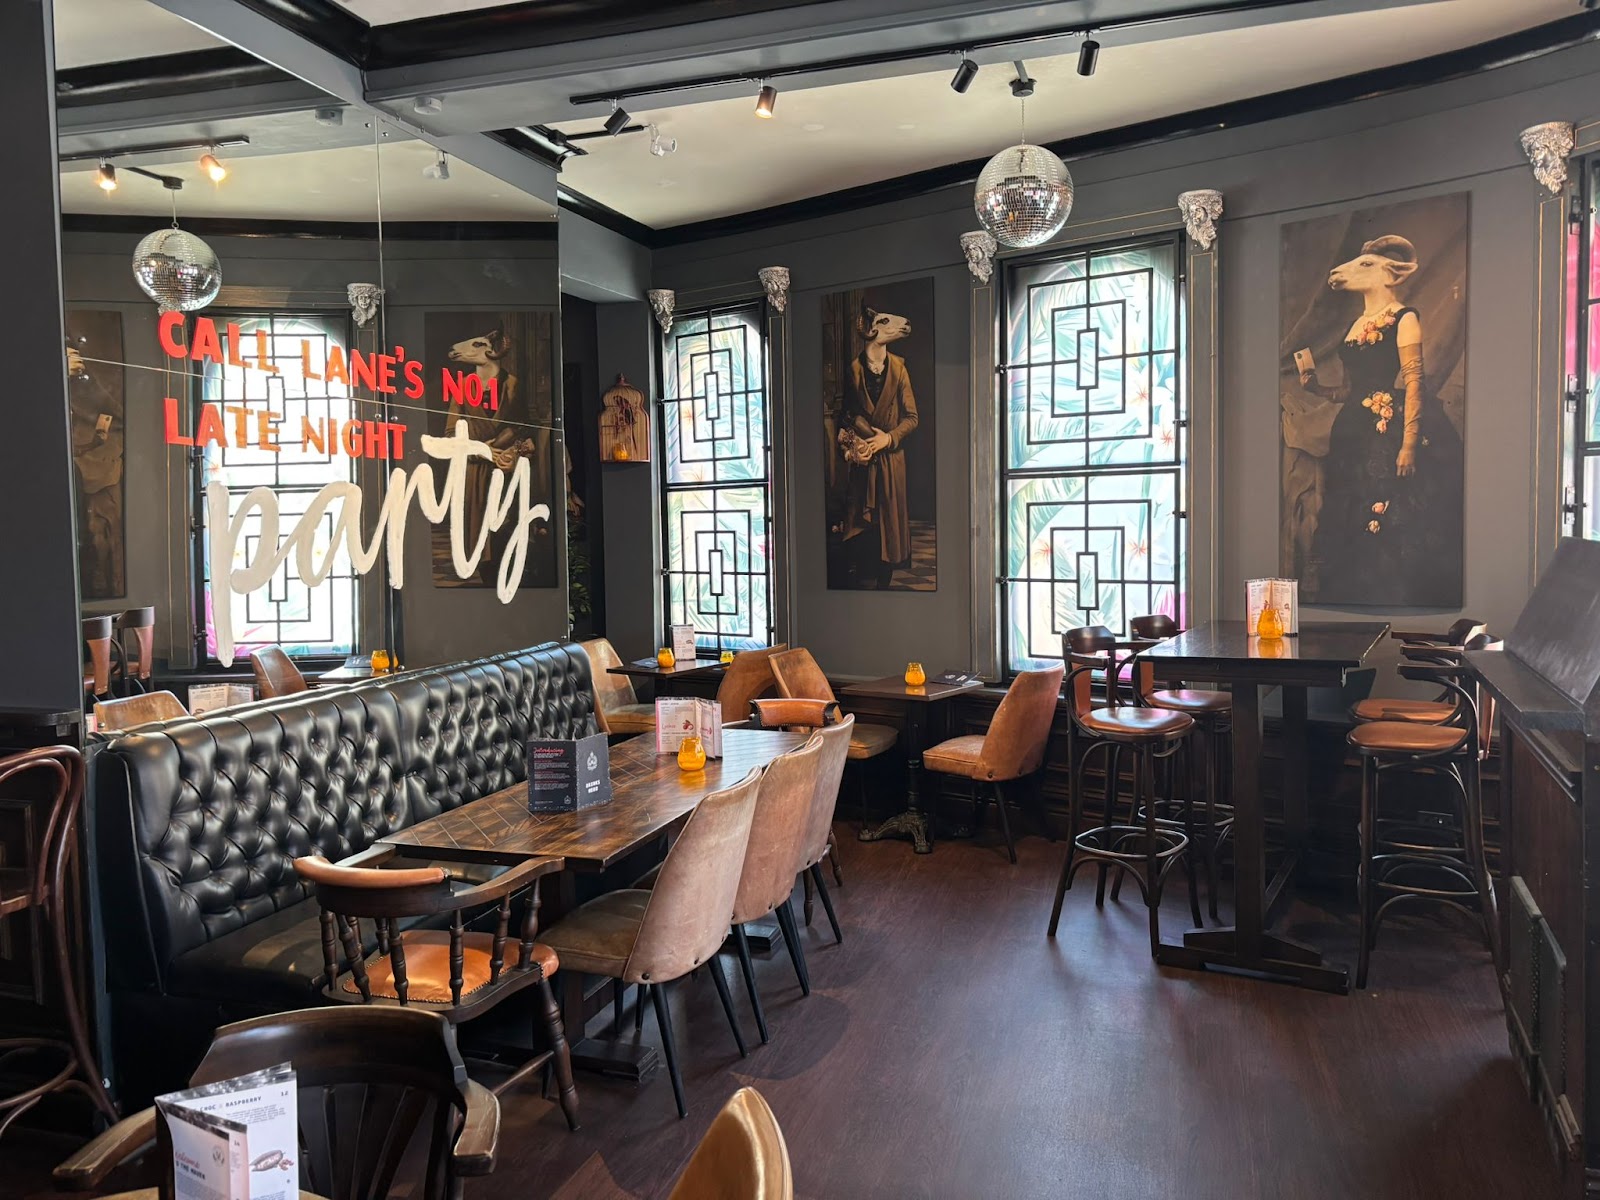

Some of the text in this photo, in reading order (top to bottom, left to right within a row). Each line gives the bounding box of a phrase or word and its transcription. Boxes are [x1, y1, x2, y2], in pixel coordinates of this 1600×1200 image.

[157, 310, 499, 411] CALL LANE'S NO.1
[163, 398, 407, 459] LATE NIGHT
[206, 419, 551, 668] party
[225, 1096, 262, 1108] RASPBERRY
